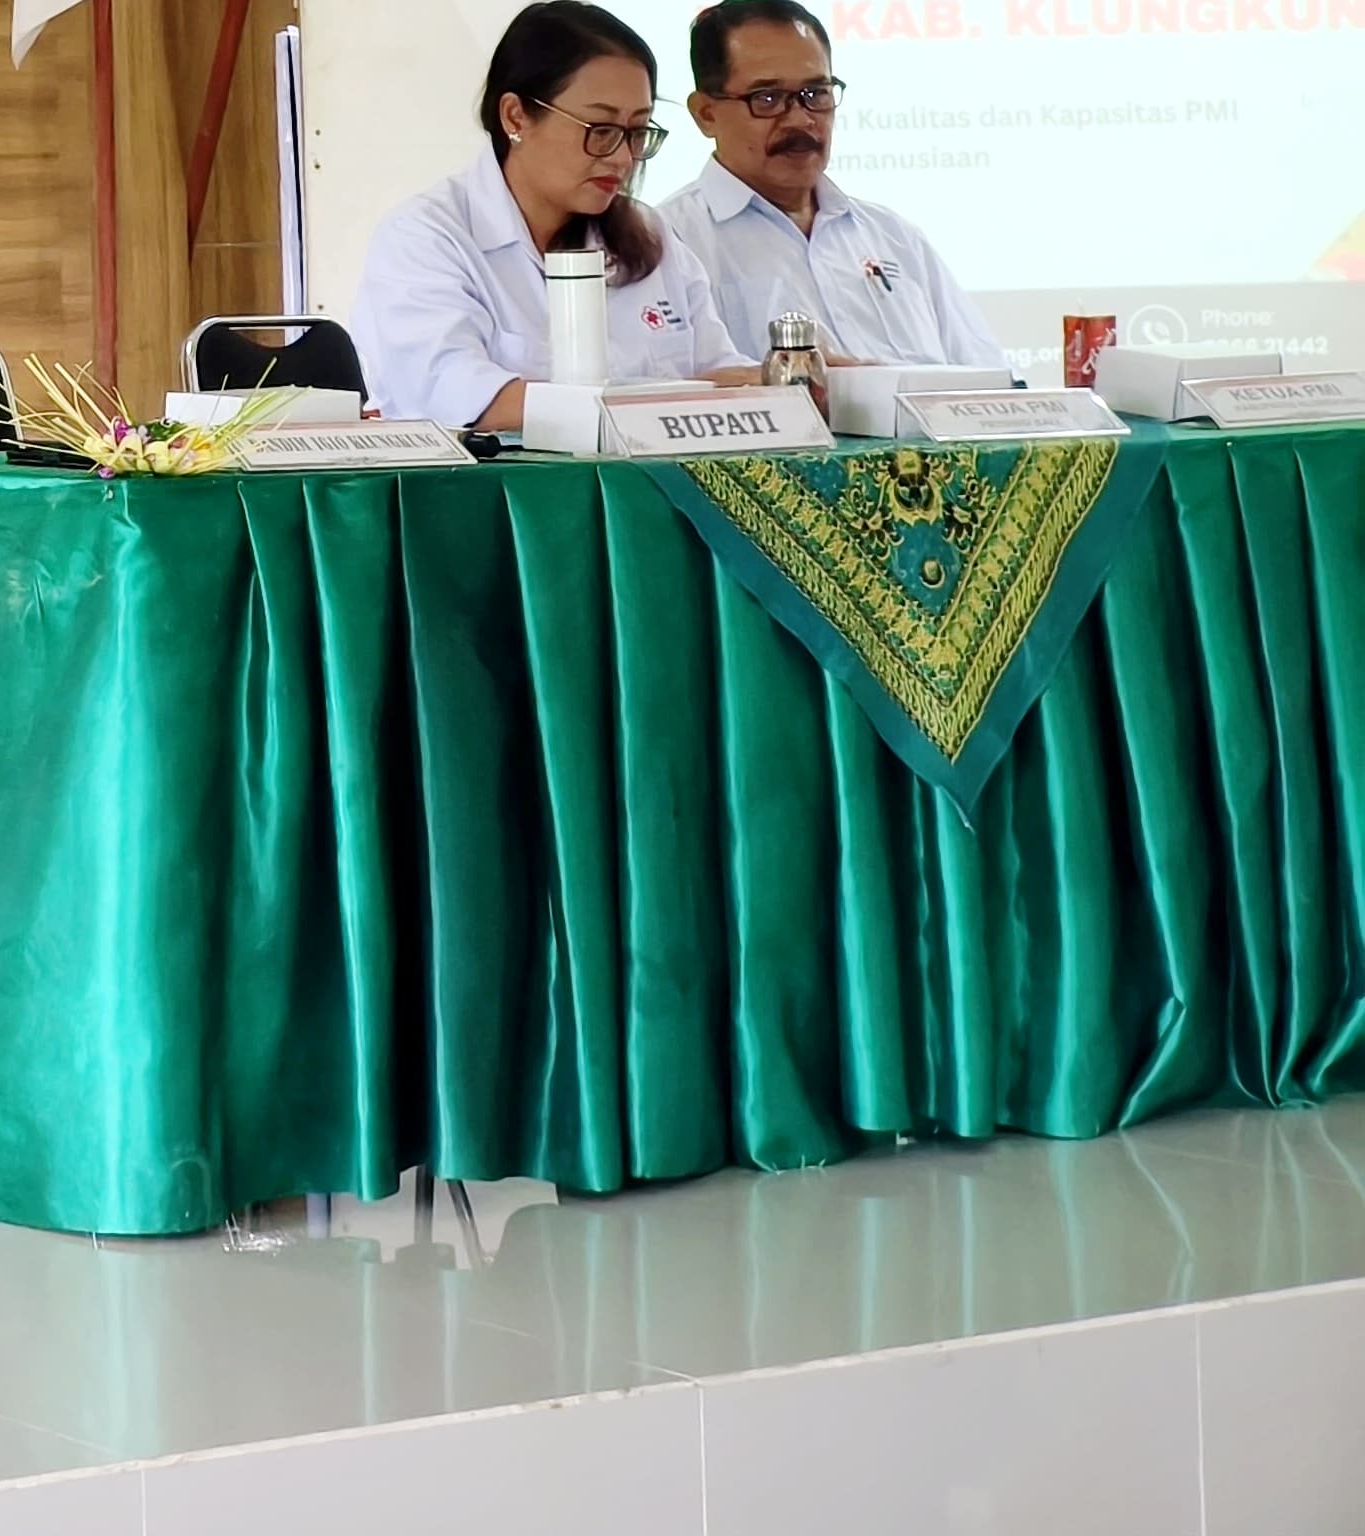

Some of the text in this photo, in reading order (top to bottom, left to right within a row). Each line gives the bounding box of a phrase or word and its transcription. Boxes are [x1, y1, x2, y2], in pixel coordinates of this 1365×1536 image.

[833, 0, 981, 40] KAB.
[857, 103, 971, 131] Kualitas
[979, 101, 1032, 128] dan
[1040, 98, 1176, 131] Kapasitas
[1185, 96, 1238, 122] PMI
[829, 147, 991, 172] emanusiaan
[1230, 385, 1303, 401] KETUA
[948, 403, 1028, 417] KETUA
[657, 410, 781, 439] BUPATI
